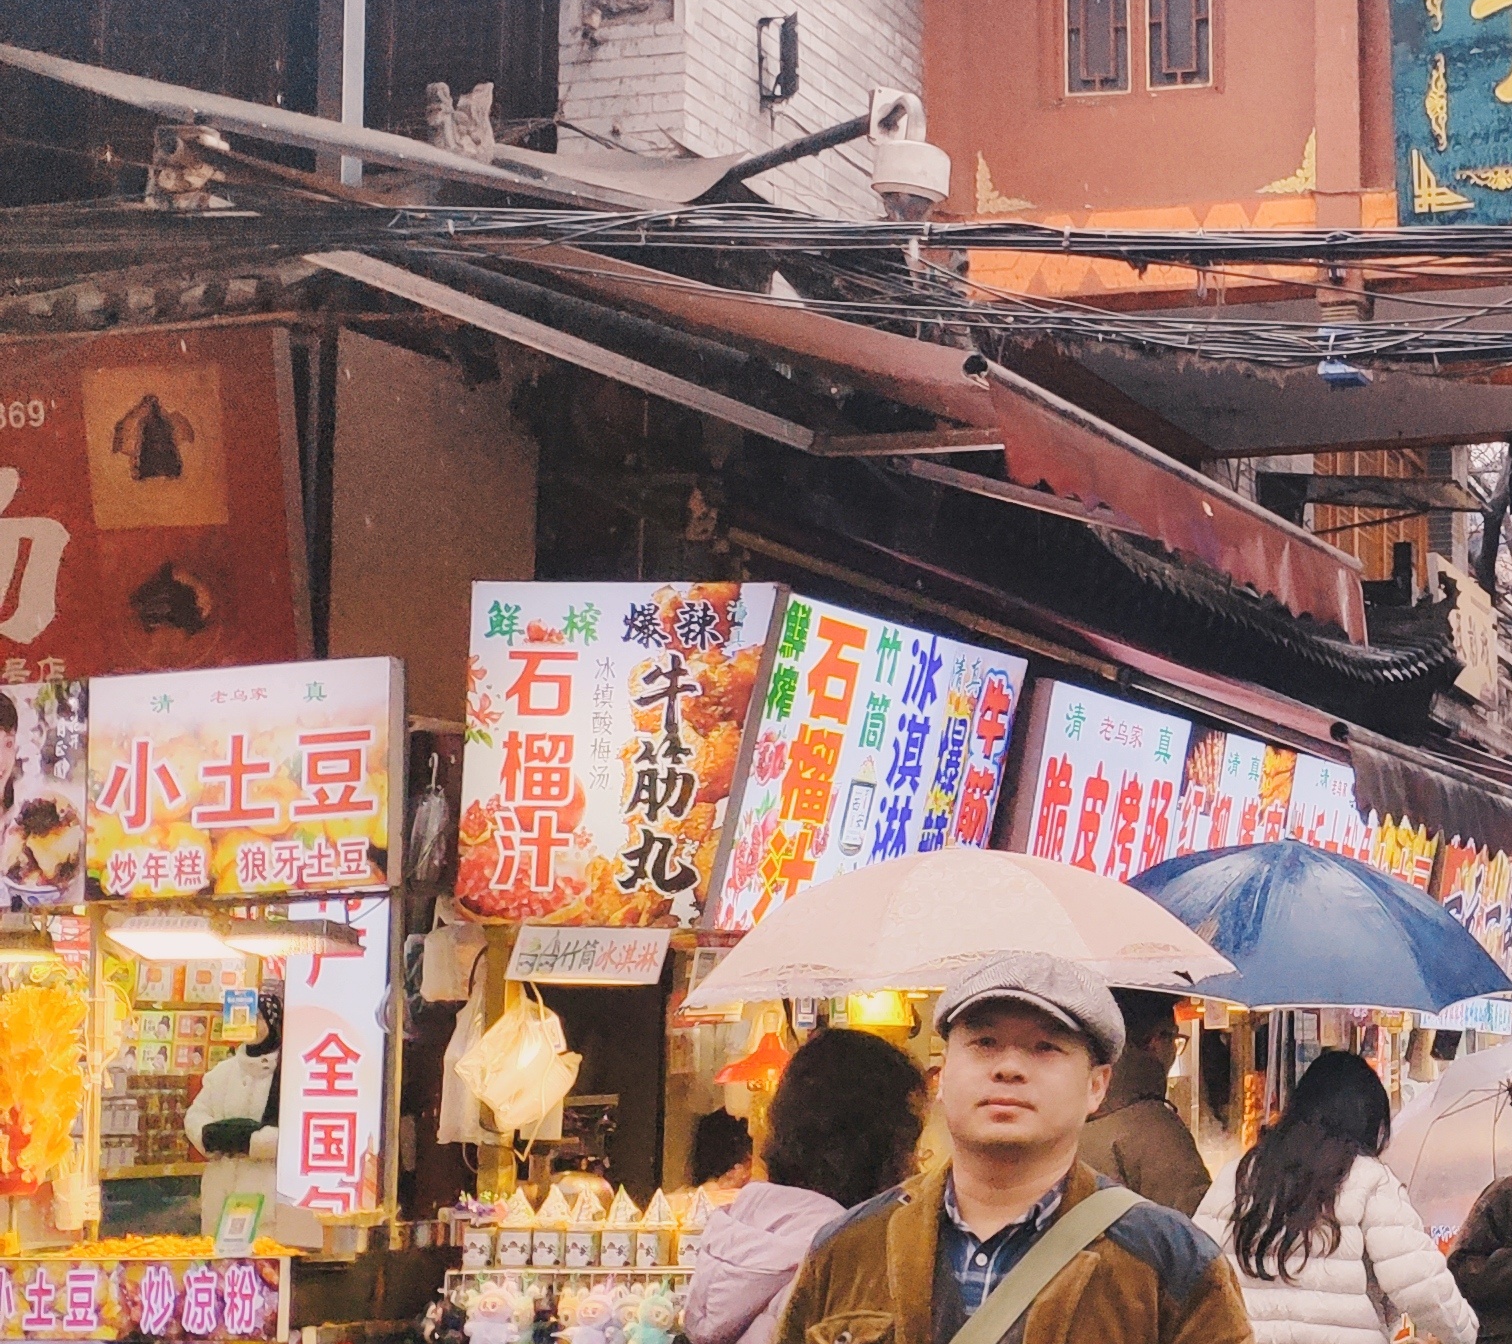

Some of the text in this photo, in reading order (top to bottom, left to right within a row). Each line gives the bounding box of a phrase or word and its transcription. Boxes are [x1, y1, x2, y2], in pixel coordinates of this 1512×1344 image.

[484, 600, 602, 646] 鲜榨
[622, 602, 724, 650] 爆辣
[766, 601, 812, 721] 鲜榨
[151, 681, 327, 713] 清 老乌家 真
[589, 657, 615, 789] 冰镇酸梅汤
[859, 626, 902, 751] 竹筒
[1065, 703, 1173, 764] 清 老乌家 真
[101, 730, 374, 830] 小土豆
[490, 651, 578, 891] 石榴汁
[617, 653, 699, 894] 牛筋丸
[752, 615, 868, 924] 石榴汁
[870, 635, 944, 864] 冰淇淋
[1228, 751, 1261, 782] 清真
[110, 841, 368, 891] 炒年糕 狼牙土豆
[141, 1267, 257, 1334] 炒凉粉
